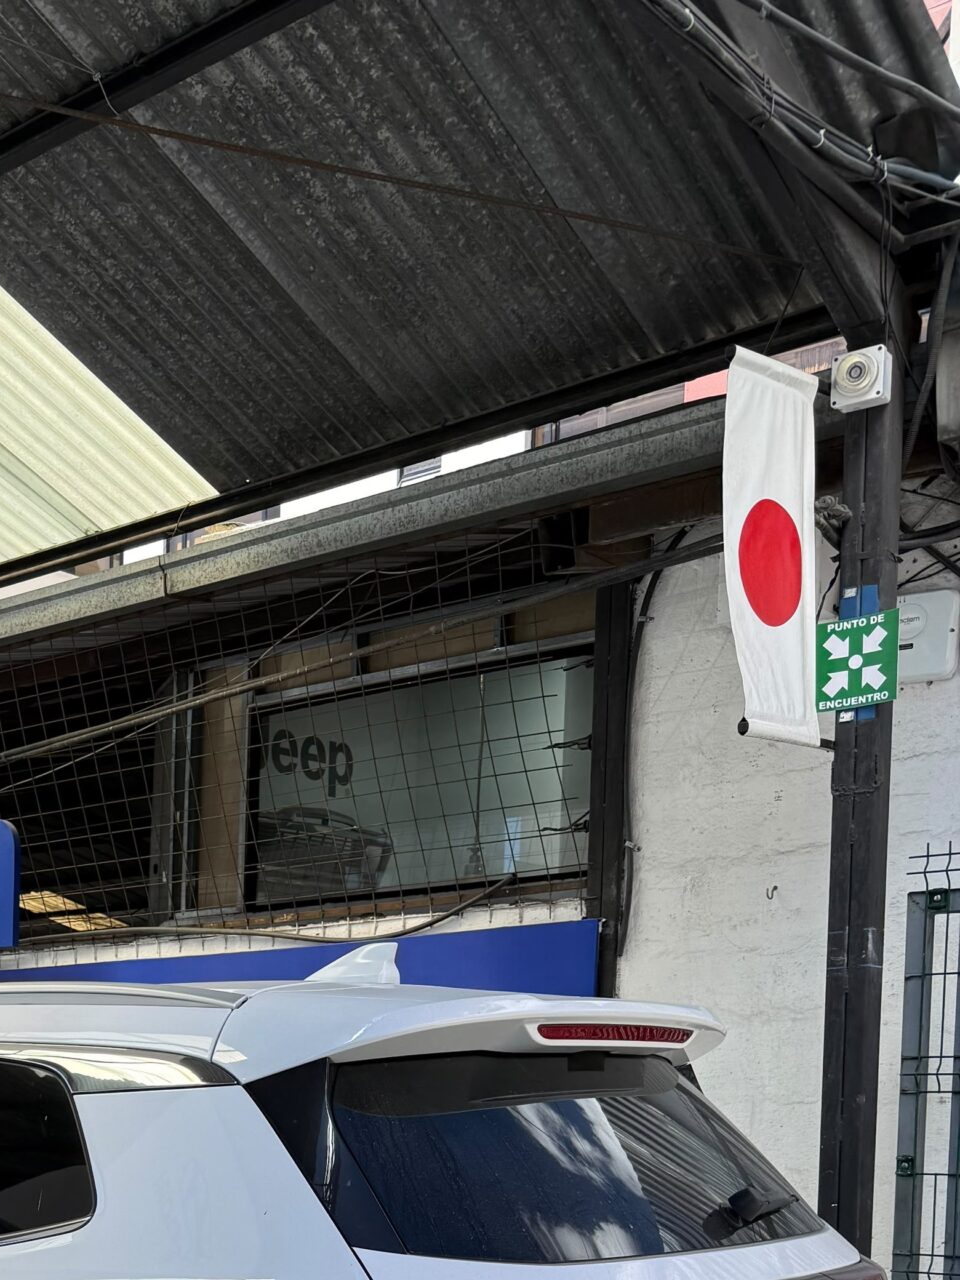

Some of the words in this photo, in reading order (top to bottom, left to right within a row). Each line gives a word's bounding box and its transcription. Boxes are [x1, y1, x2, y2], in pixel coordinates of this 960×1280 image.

[827, 617, 867, 632] PUNTO
[870, 613, 885, 625] DE
[818, 691, 889, 710] ENCUENTRO
